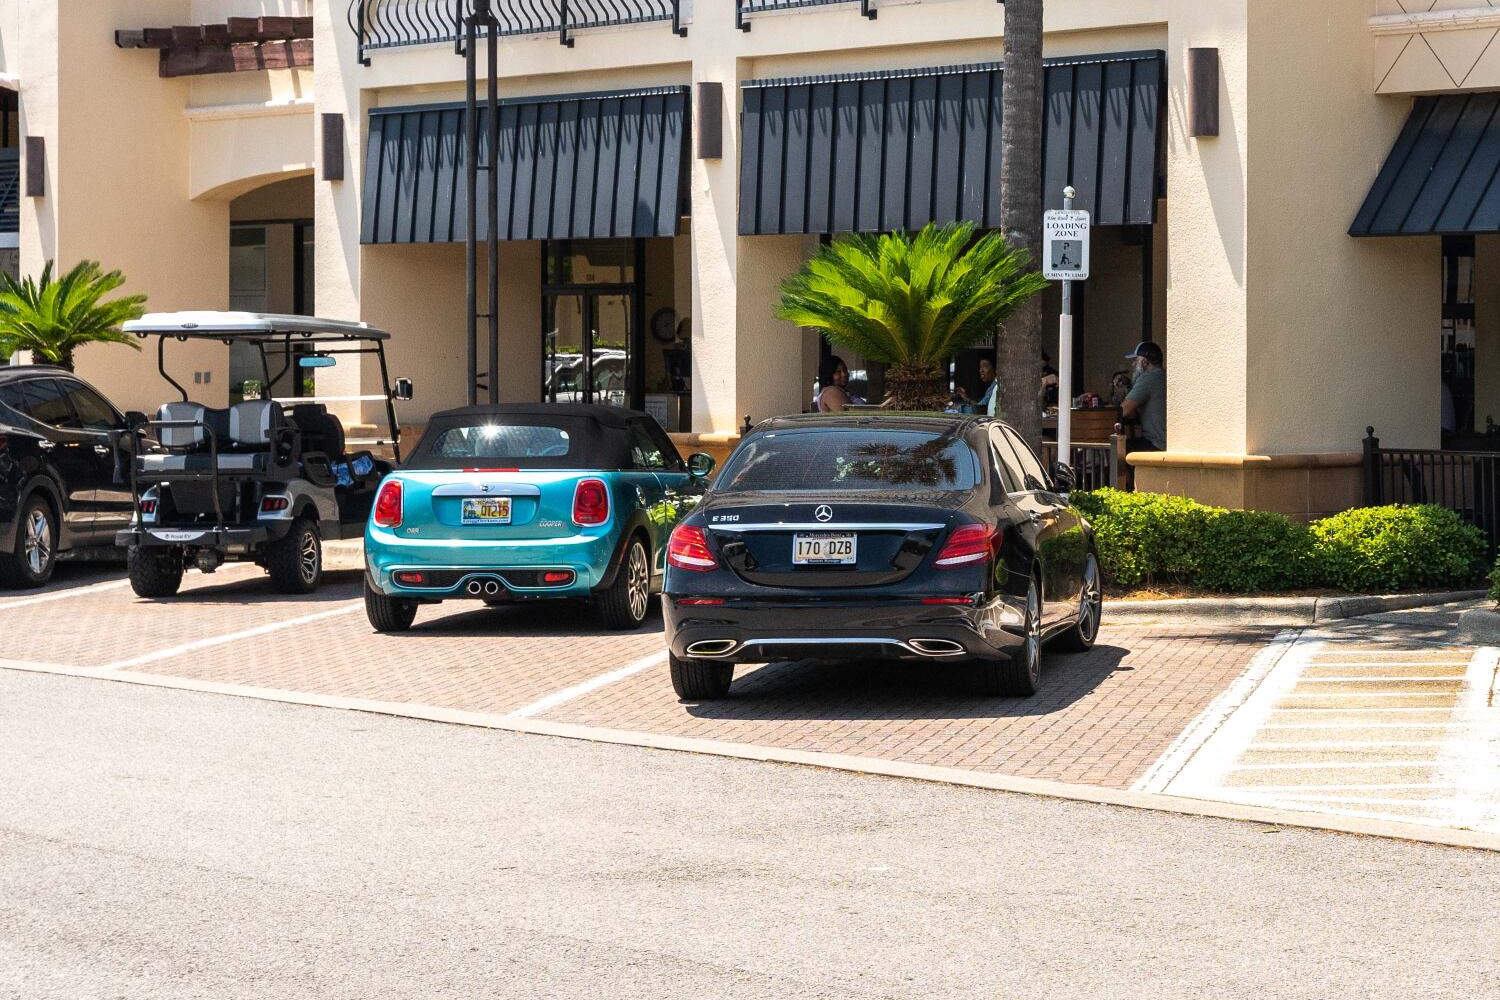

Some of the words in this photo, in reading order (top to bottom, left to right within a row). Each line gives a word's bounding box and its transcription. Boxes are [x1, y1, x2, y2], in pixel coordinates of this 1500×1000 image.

[1047, 222, 1087, 230] LOADING
[799, 541, 820, 555] 170
[829, 541, 852, 555] DZB
